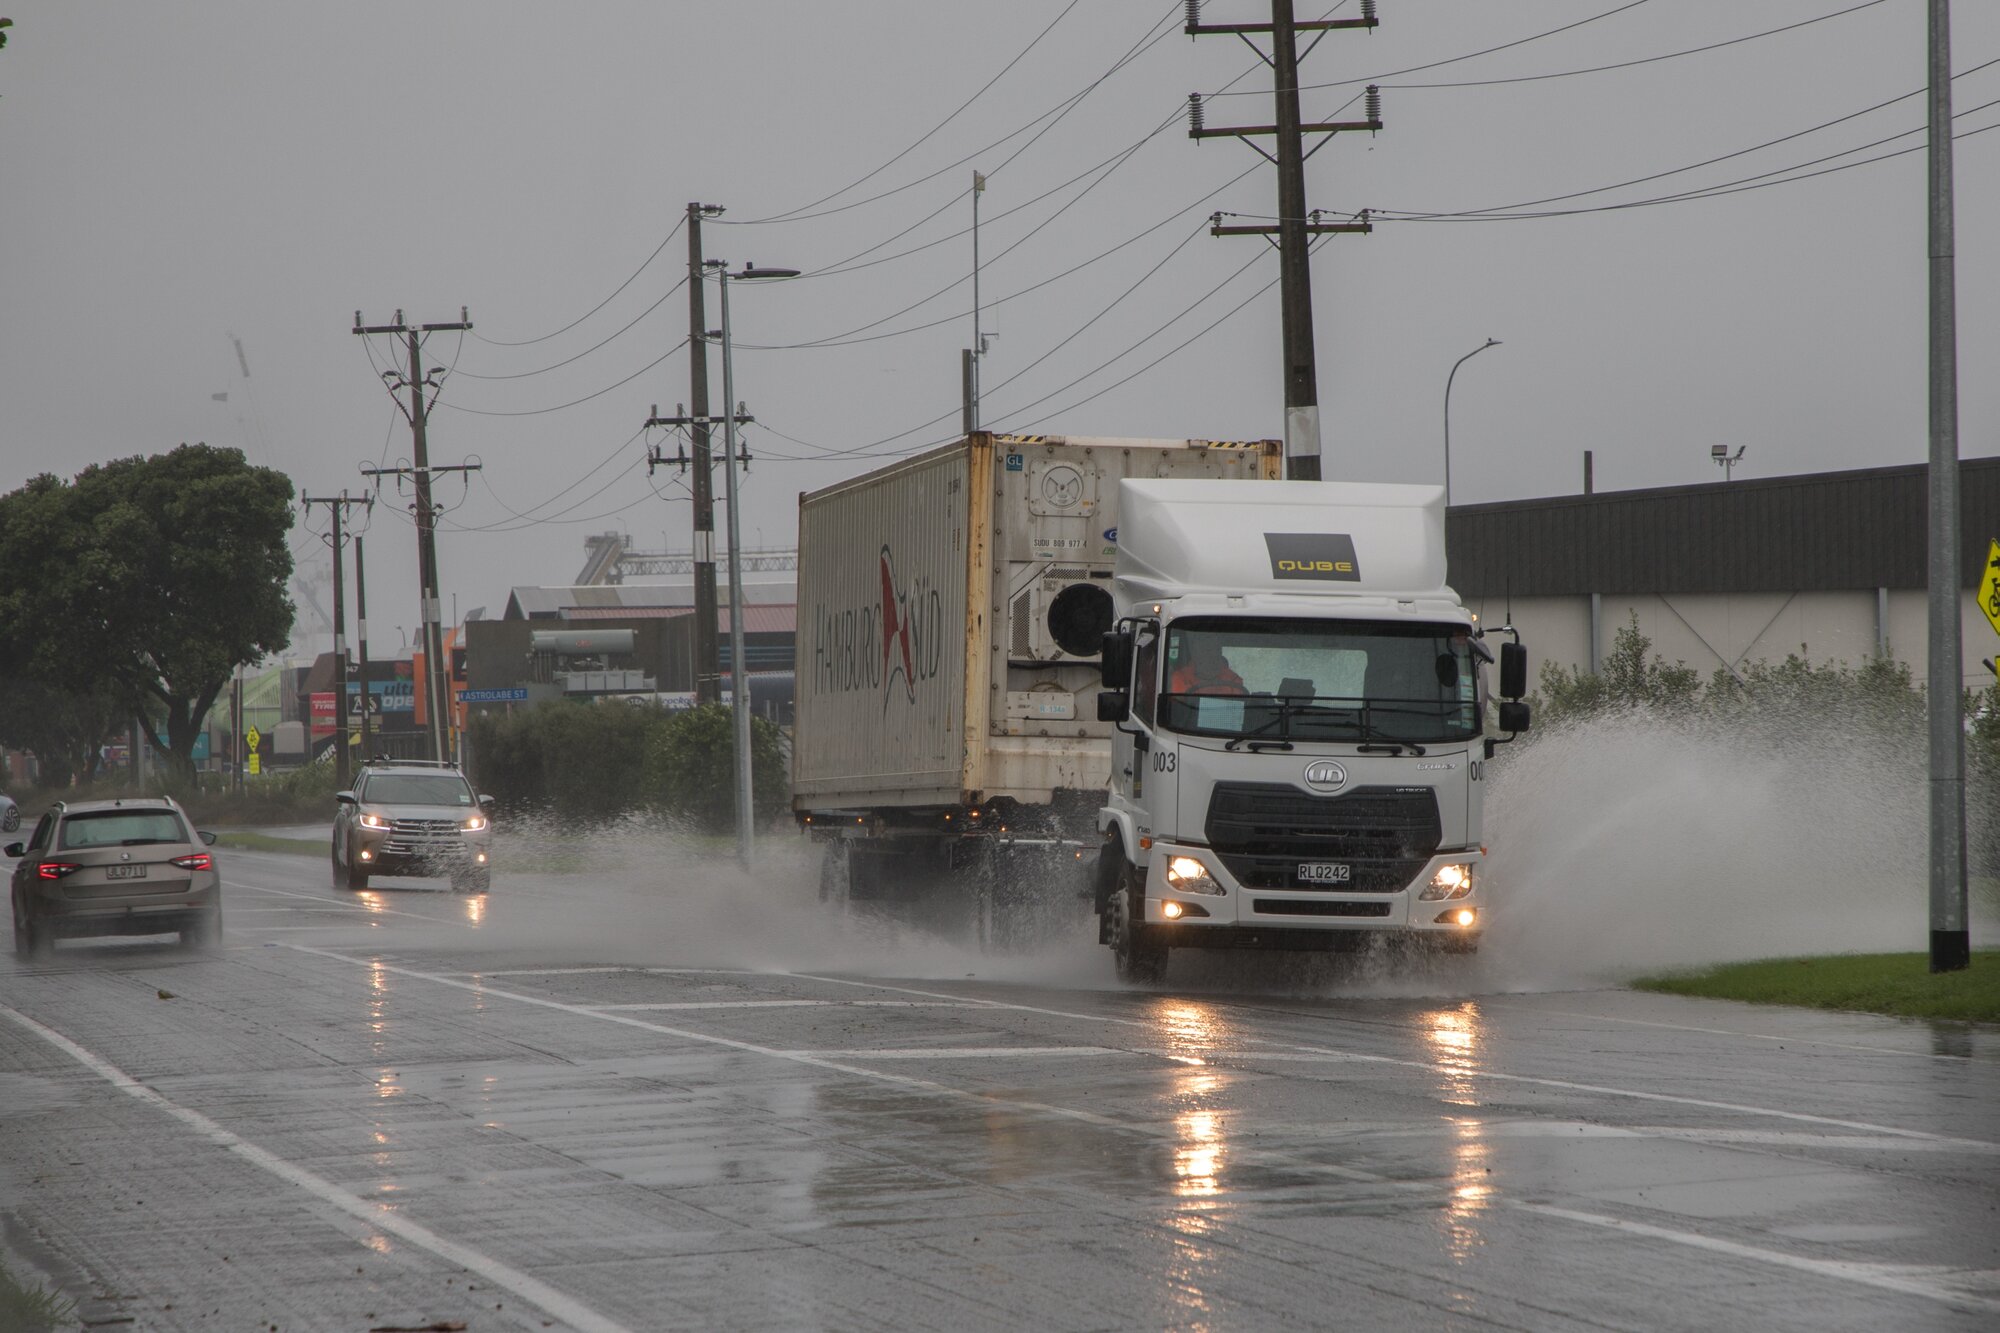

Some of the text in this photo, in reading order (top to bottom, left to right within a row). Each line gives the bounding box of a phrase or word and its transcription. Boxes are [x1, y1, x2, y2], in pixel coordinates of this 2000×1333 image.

[1007, 455, 1022, 466] GL
[1033, 538, 1050, 547] SUDU
[1068, 539, 1081, 548] 977
[1278, 560, 1353, 572] QUBE
[815, 576, 941, 696] HAMBURG SÜD
[465, 689, 524, 701] ASTROLABE ST
[1153, 751, 1176, 773] 003
[1470, 760, 1484, 782] 00
[1299, 866, 1349, 880] RLQ242
